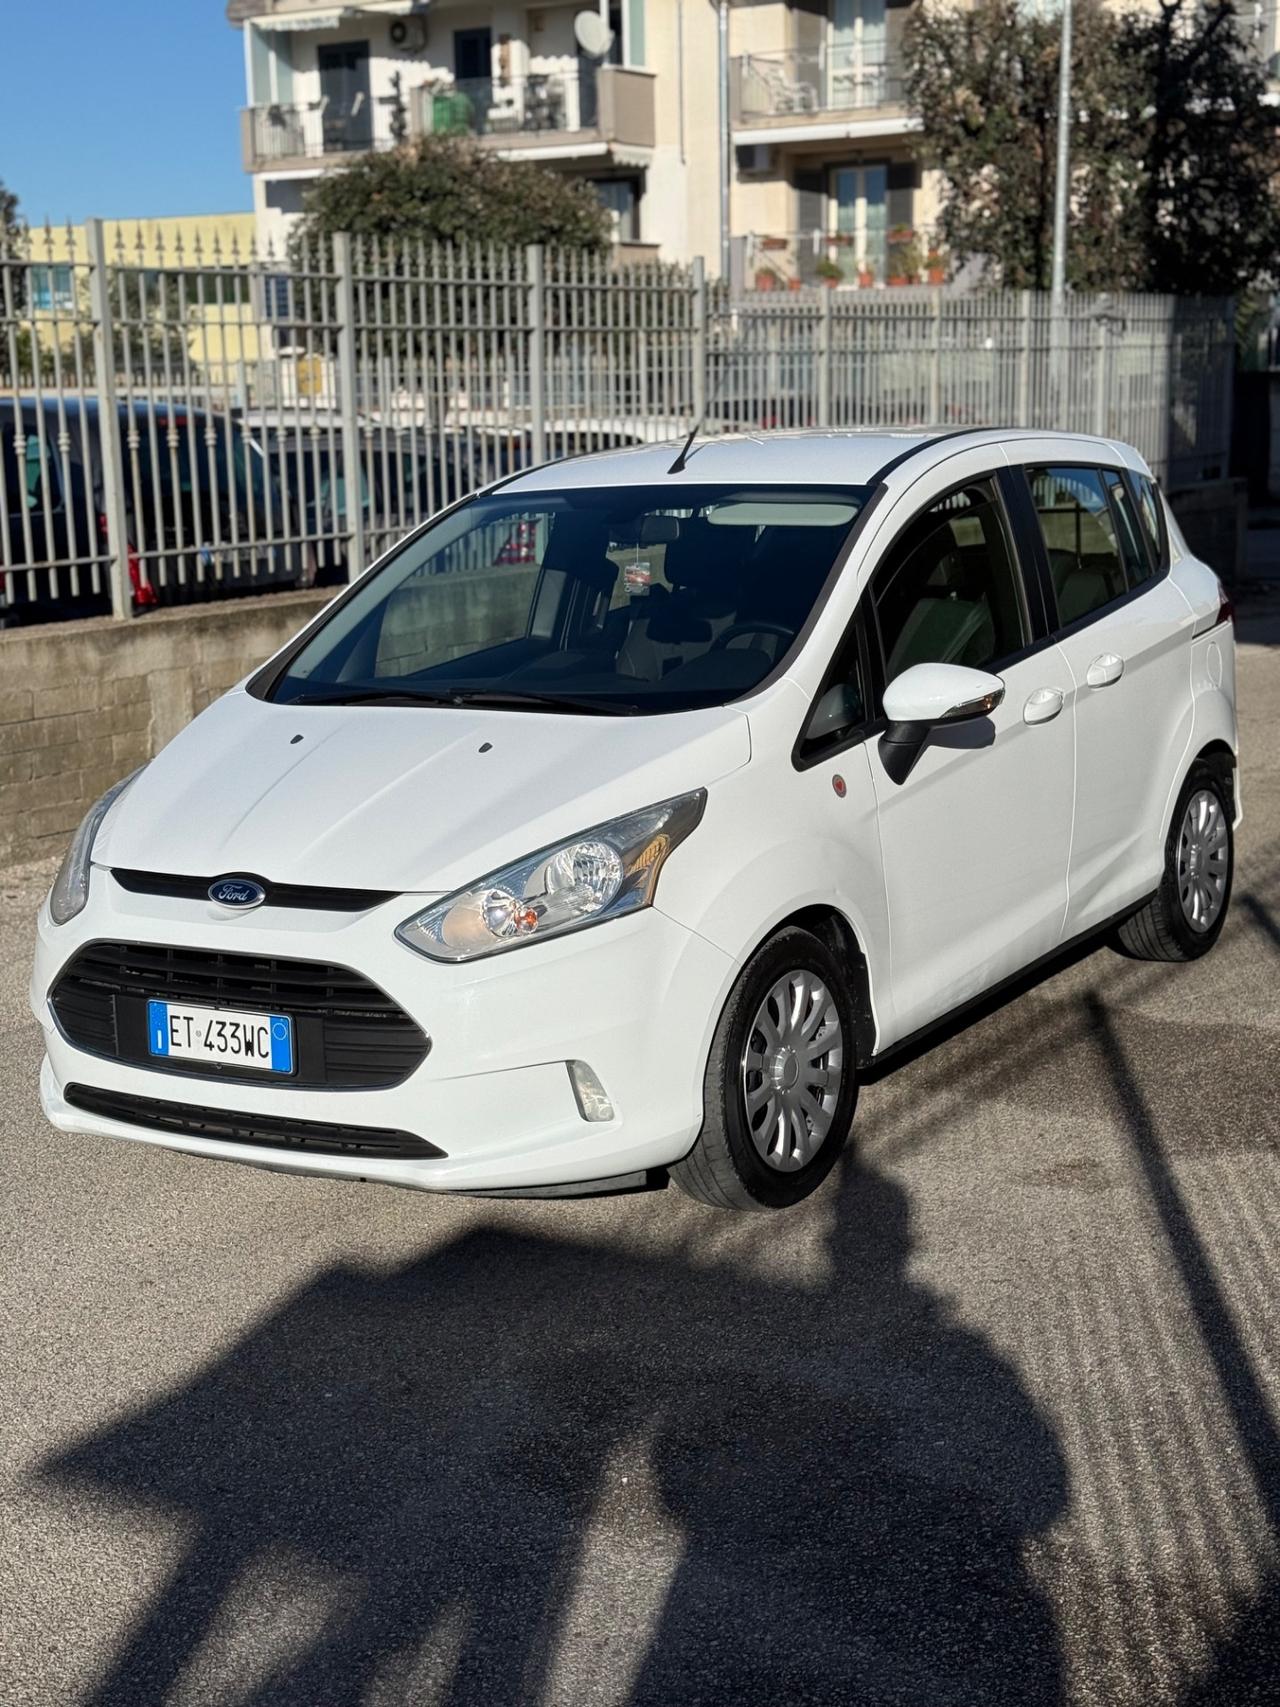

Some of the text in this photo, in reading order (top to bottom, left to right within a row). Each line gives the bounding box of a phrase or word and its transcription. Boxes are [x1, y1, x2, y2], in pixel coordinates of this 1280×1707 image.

[218, 883, 250, 901] Ford
[169, 1015, 270, 1058] ET 433WC
